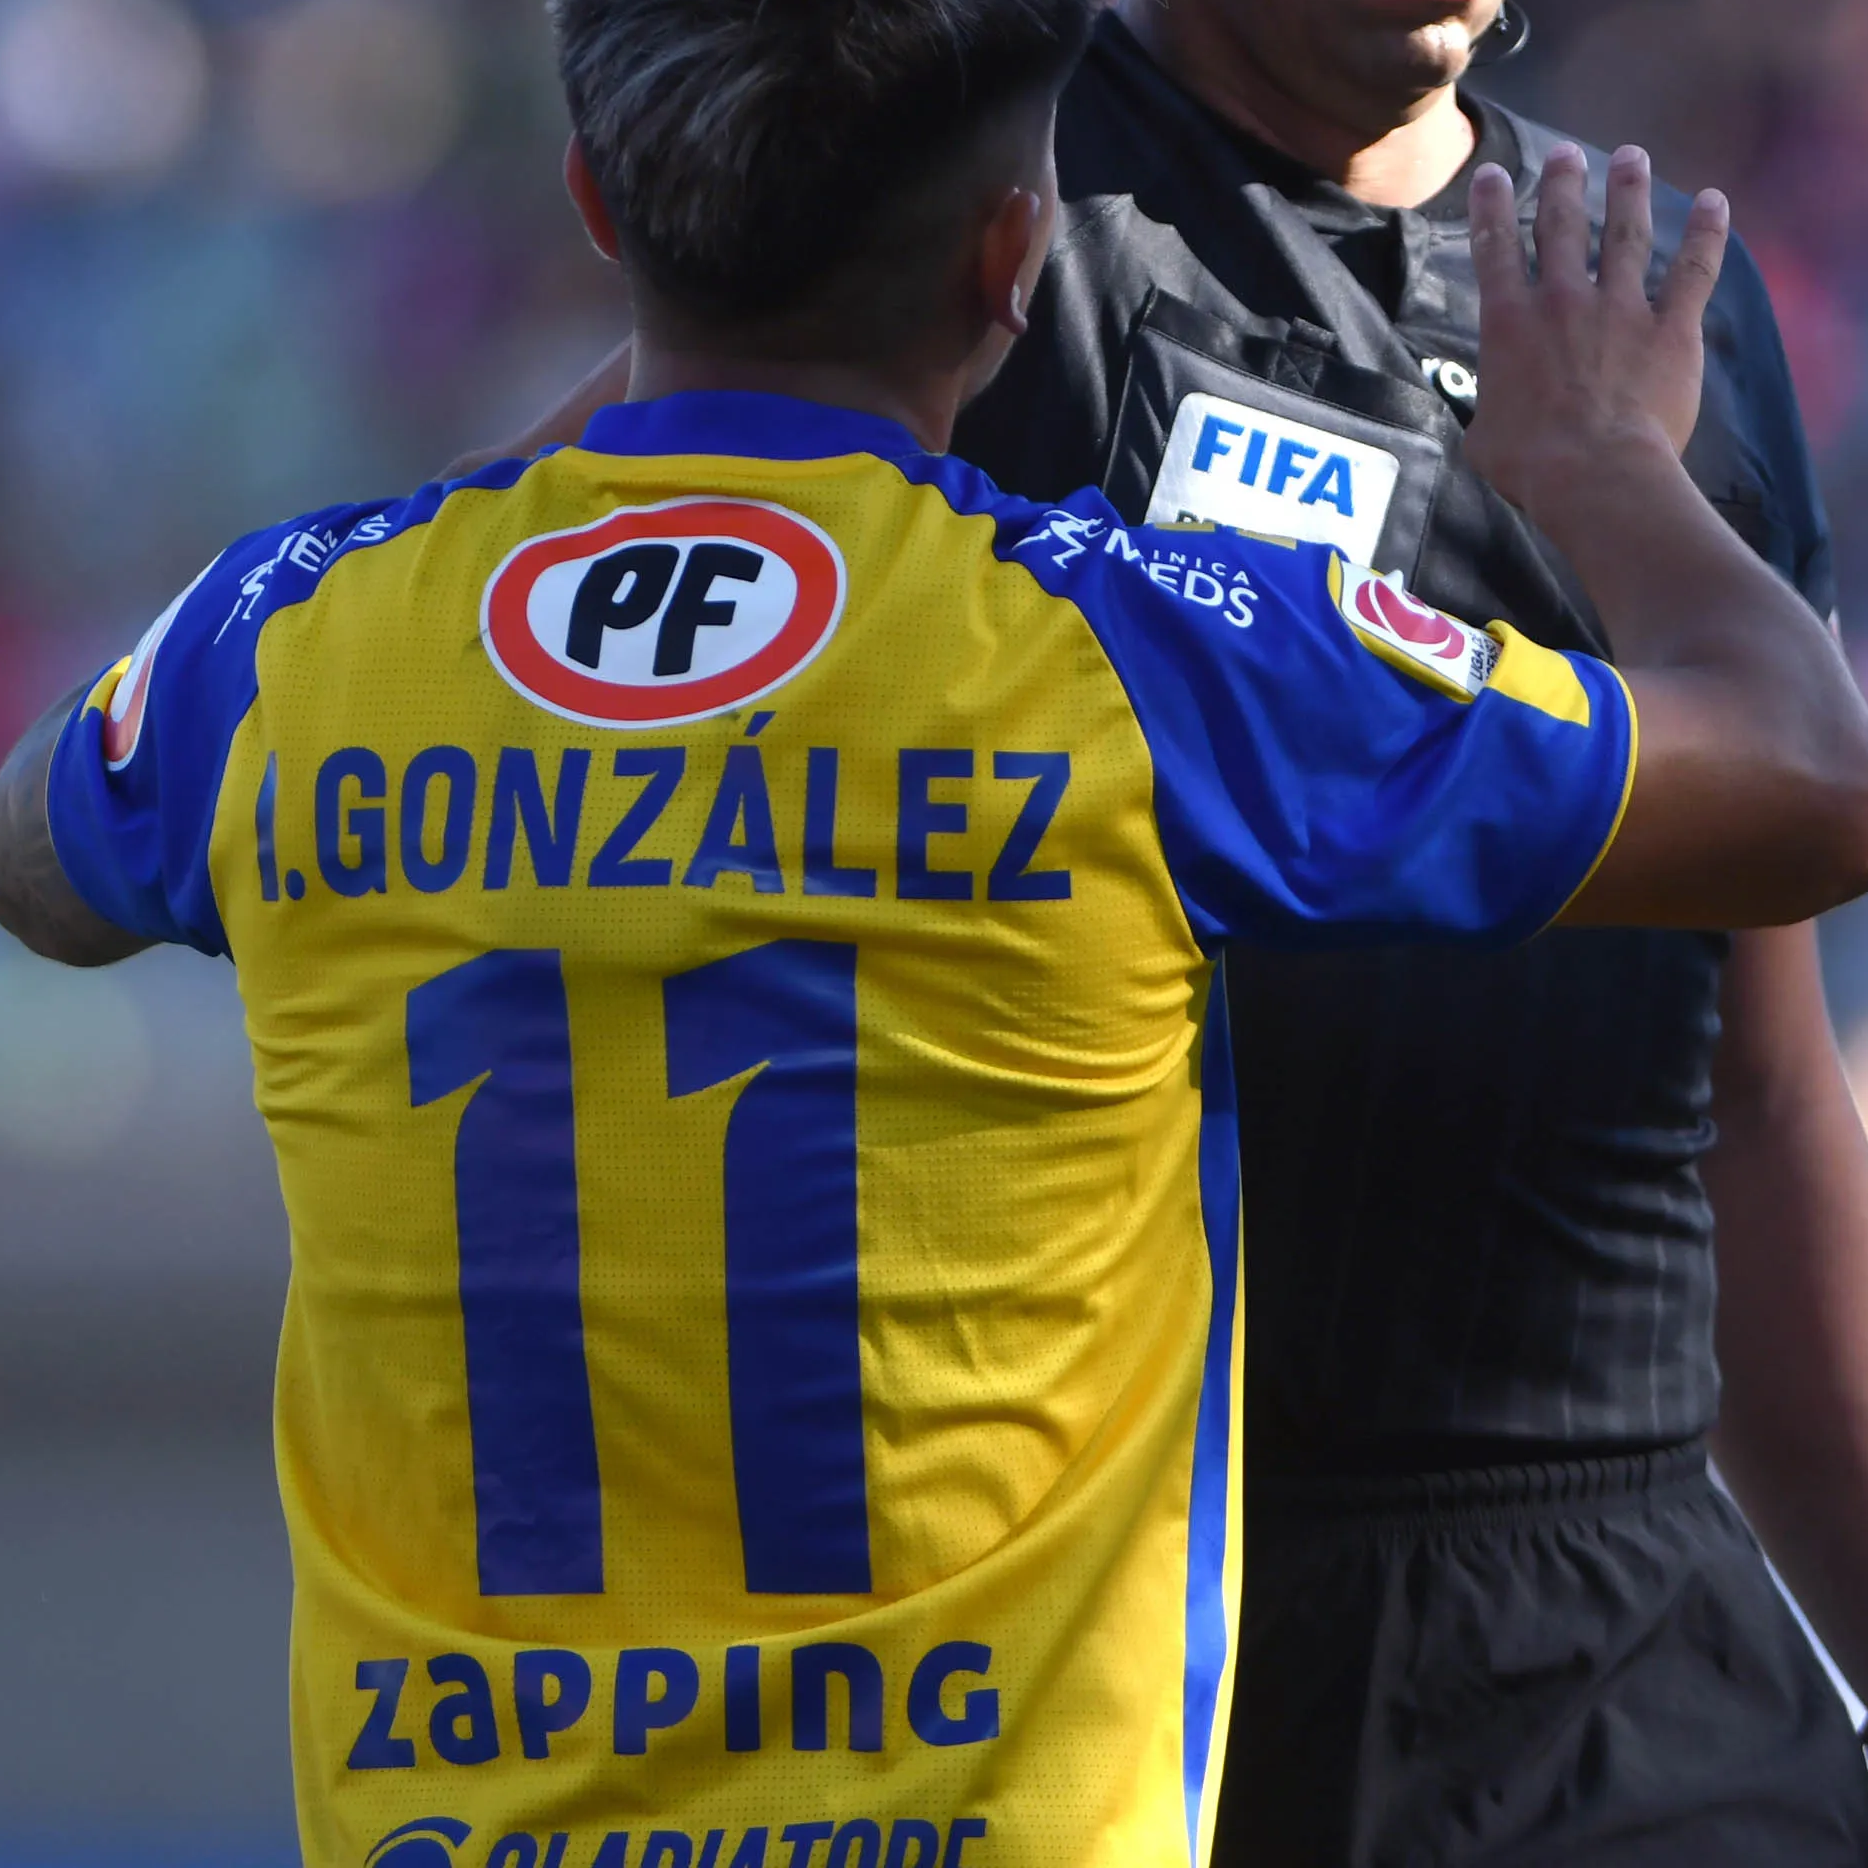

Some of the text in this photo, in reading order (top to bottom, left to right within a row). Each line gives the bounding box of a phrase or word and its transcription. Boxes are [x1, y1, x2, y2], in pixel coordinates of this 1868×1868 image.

[1192, 412, 1354, 518] FIFA
[564, 543, 765, 677] PF
[1152, 549, 1250, 586] INICA
[255, 711, 1073, 902] I.GONZÁLEZ
[405, 938, 872, 1596] 11
